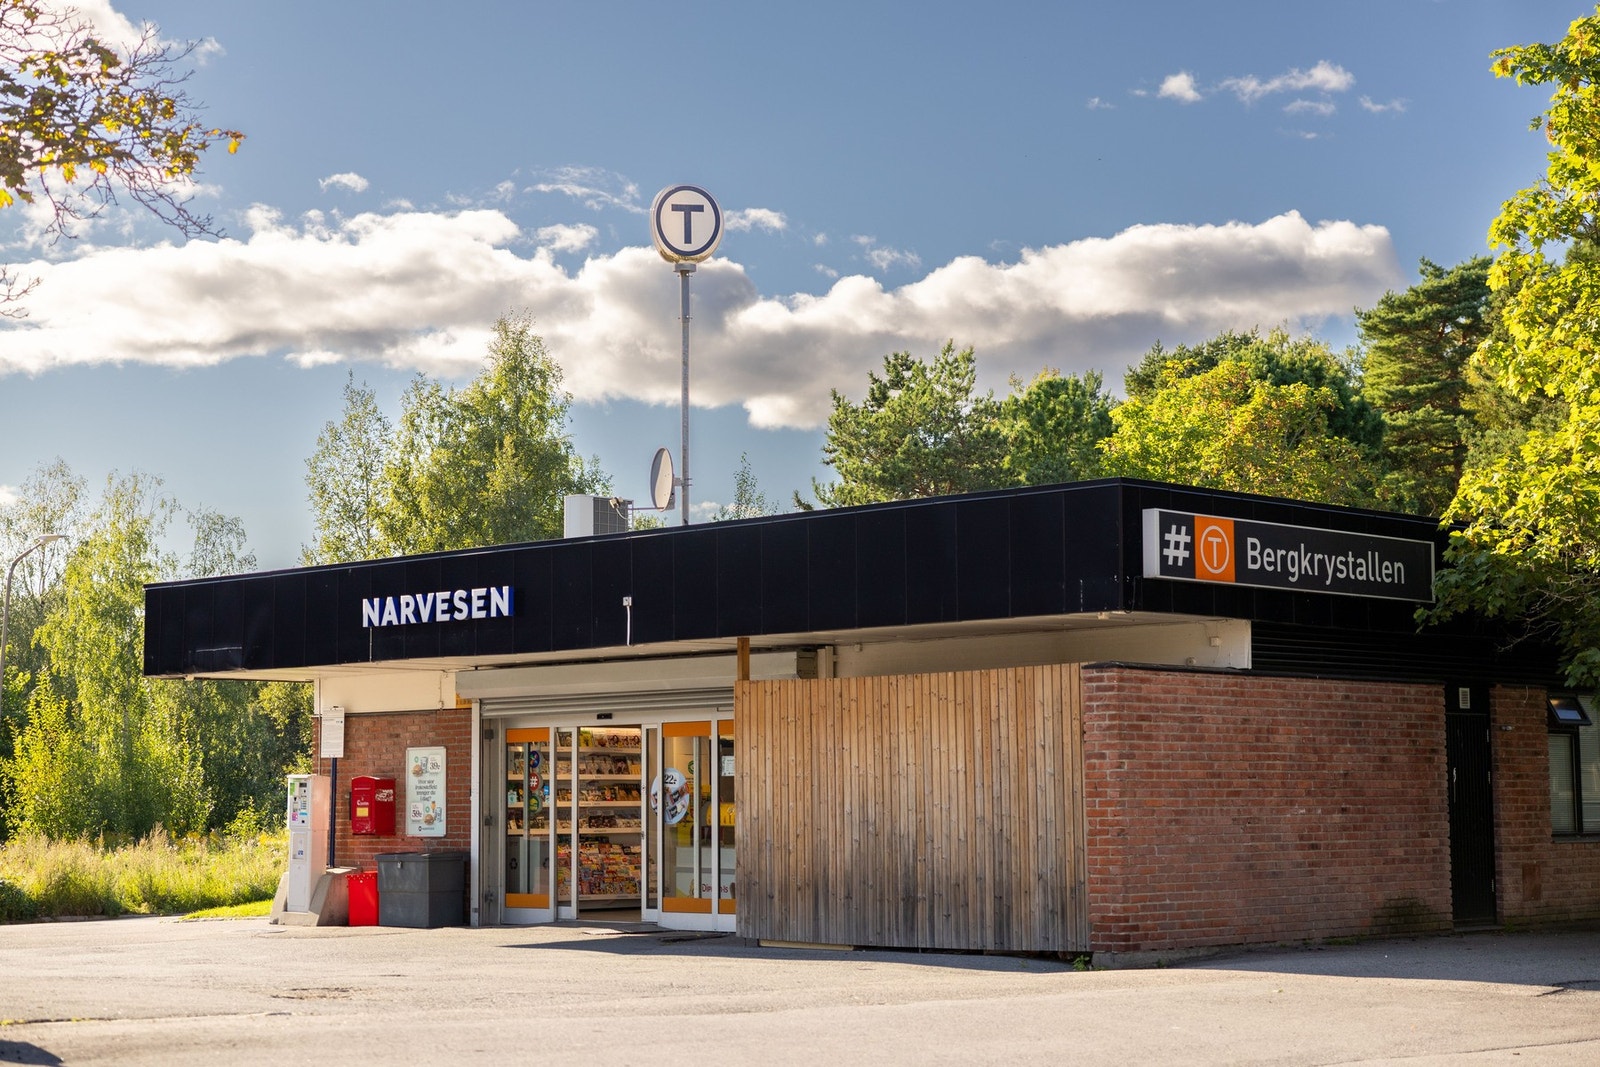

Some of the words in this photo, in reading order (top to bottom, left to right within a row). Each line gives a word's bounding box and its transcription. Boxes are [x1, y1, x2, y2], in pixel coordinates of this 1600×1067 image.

[671, 203, 705, 245] T
[1247, 537, 1406, 585] Bergkrystallen
[362, 585, 513, 628] NARVESEN
